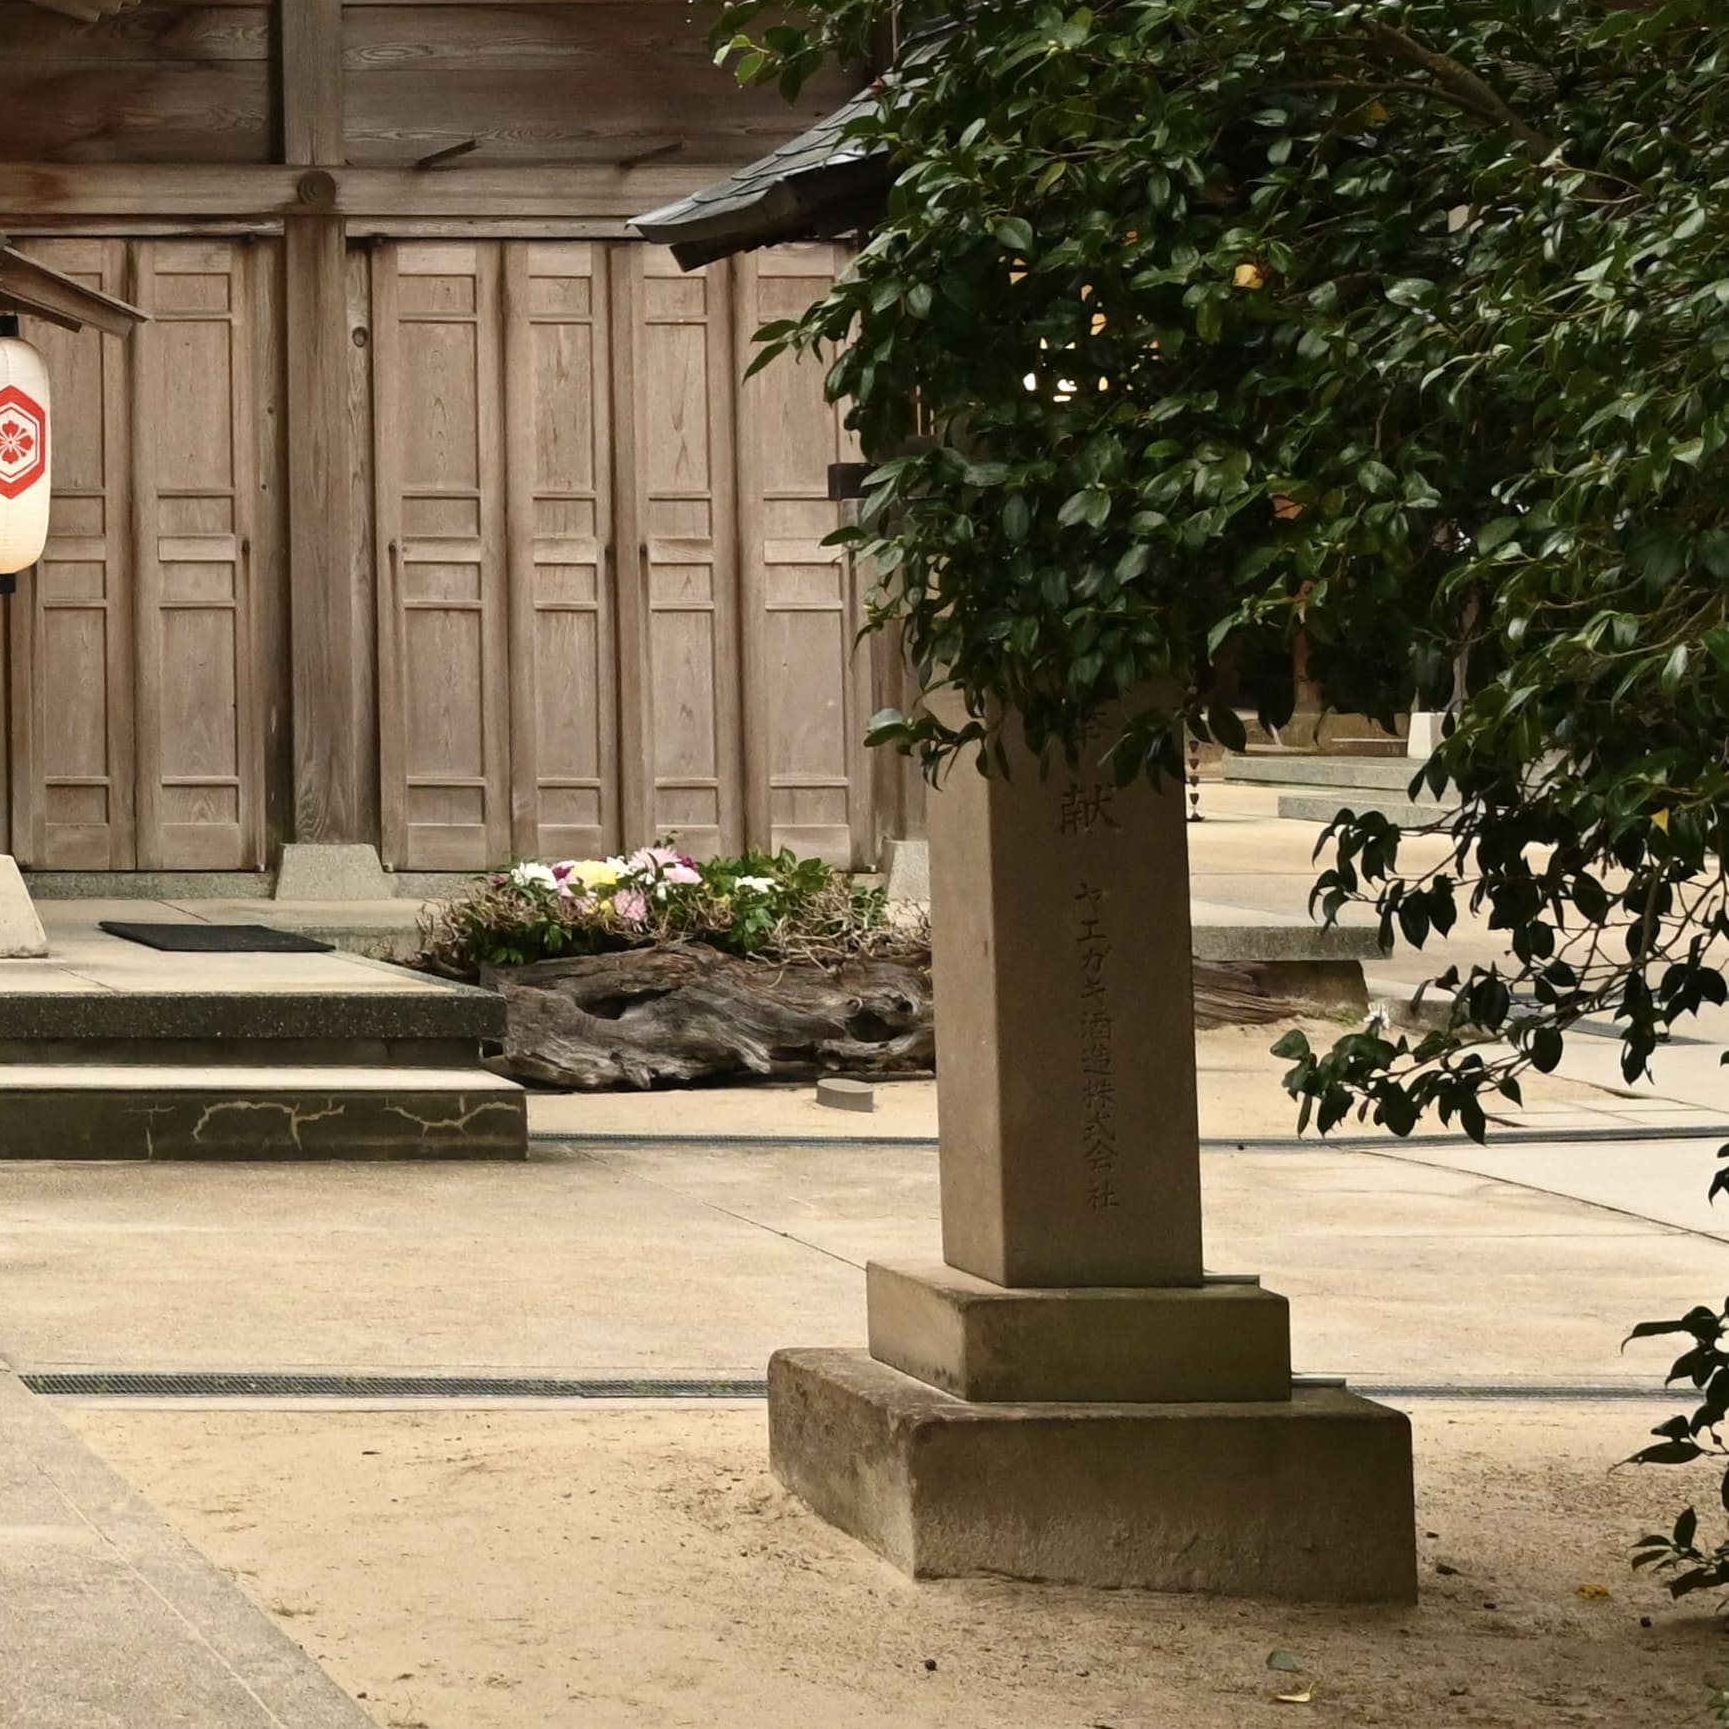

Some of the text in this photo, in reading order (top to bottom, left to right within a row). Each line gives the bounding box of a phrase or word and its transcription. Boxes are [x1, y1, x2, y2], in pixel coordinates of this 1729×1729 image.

[1074, 882, 1120, 1215] ヤエガキ酒造株式会社
